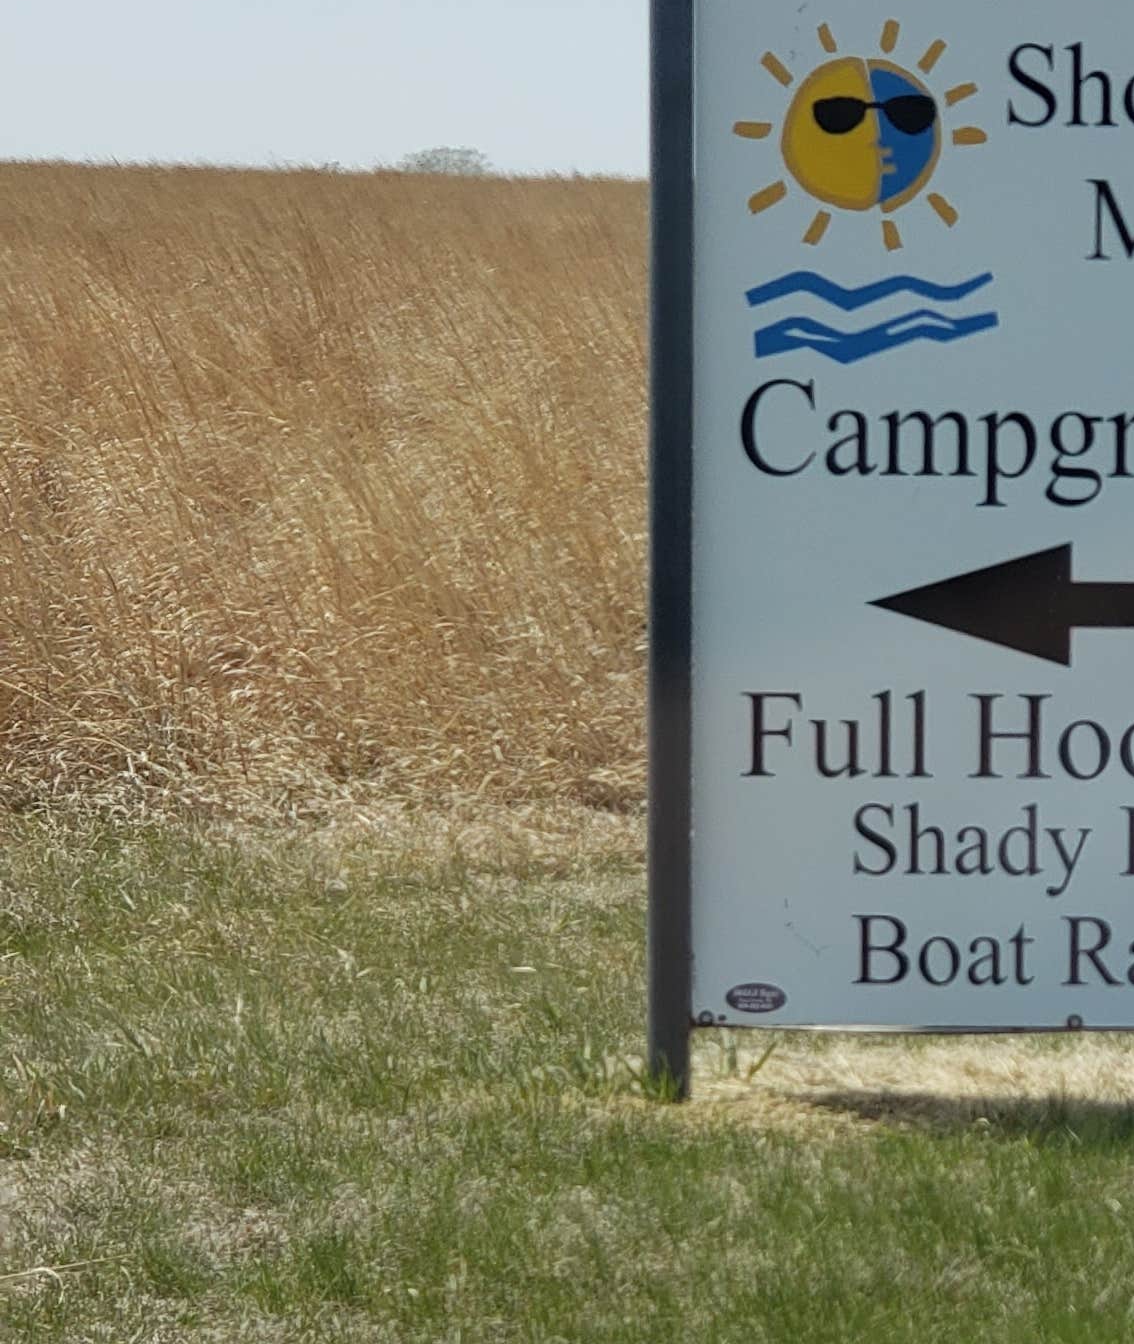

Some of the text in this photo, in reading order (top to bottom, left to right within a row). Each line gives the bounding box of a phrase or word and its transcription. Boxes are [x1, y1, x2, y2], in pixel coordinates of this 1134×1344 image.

[741, 690, 933, 778] Full
[854, 803, 1091, 897] Shady
[852, 915, 1034, 986] Boat
